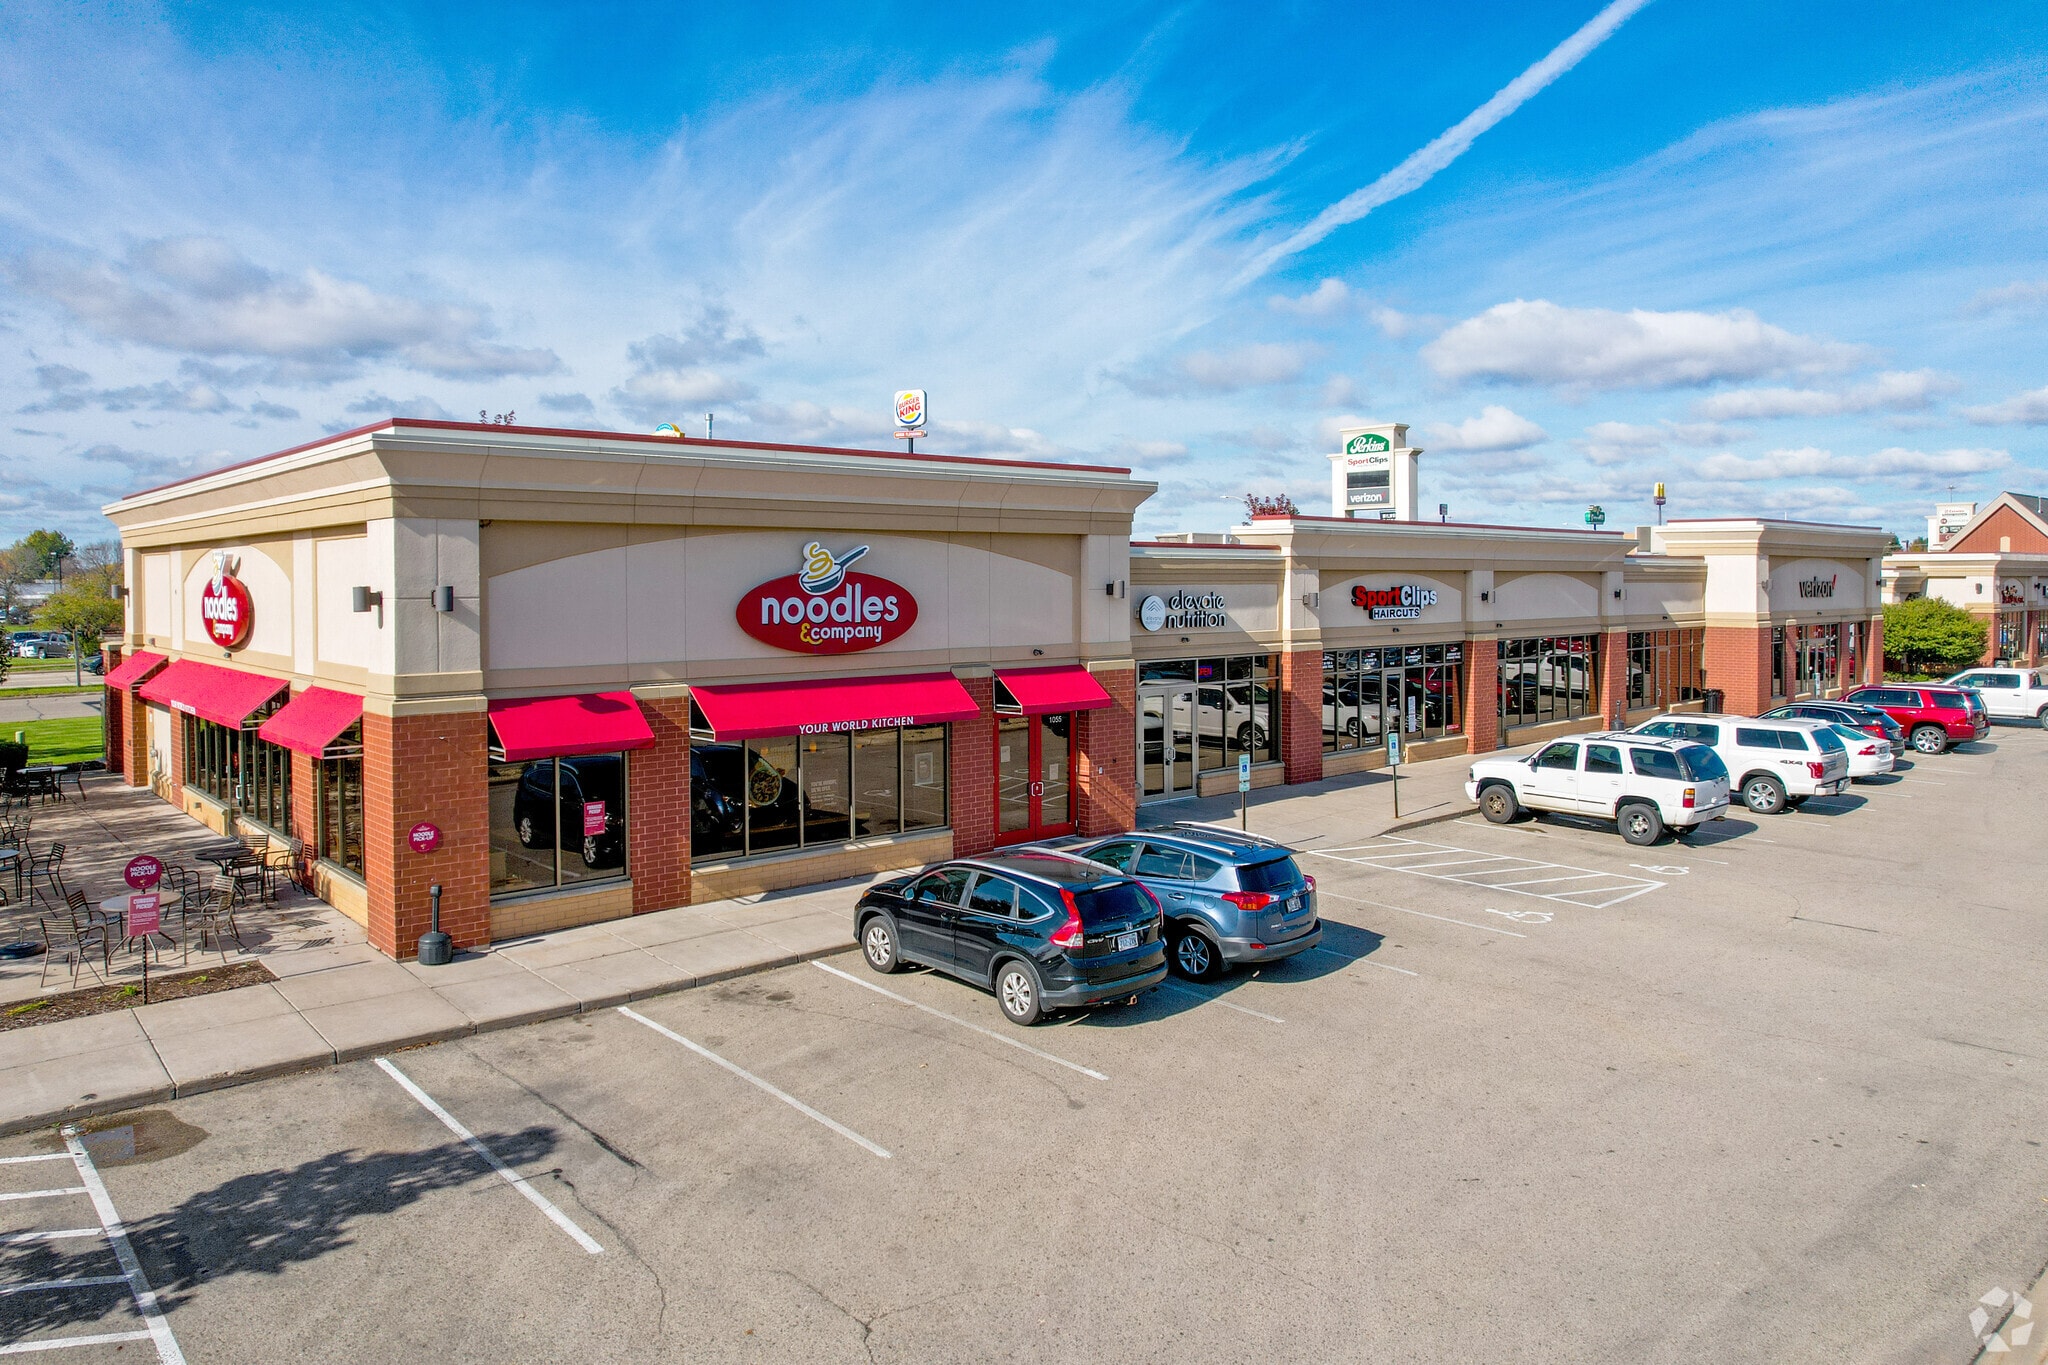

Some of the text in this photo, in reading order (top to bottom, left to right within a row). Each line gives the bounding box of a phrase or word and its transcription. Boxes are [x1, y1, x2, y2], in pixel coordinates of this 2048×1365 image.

[899, 397, 919, 410] BURGER
[900, 402, 920, 418] KING
[1350, 493, 1382, 503] verizon
[1799, 576, 1833, 599] verizon
[203, 585, 237, 622] noodles
[761, 582, 899, 625] noodles
[1169, 590, 1225, 610] elevate
[1166, 611, 1226, 629] nutrition
[1373, 608, 1420, 619] HAIRCUTS
[799, 716, 914, 735] YOUR WORLD KITCHEN
[1049, 715, 1063, 723] 1055
[130, 864, 157, 873] NOODLE
[131, 869, 156, 877] PICK-UP
